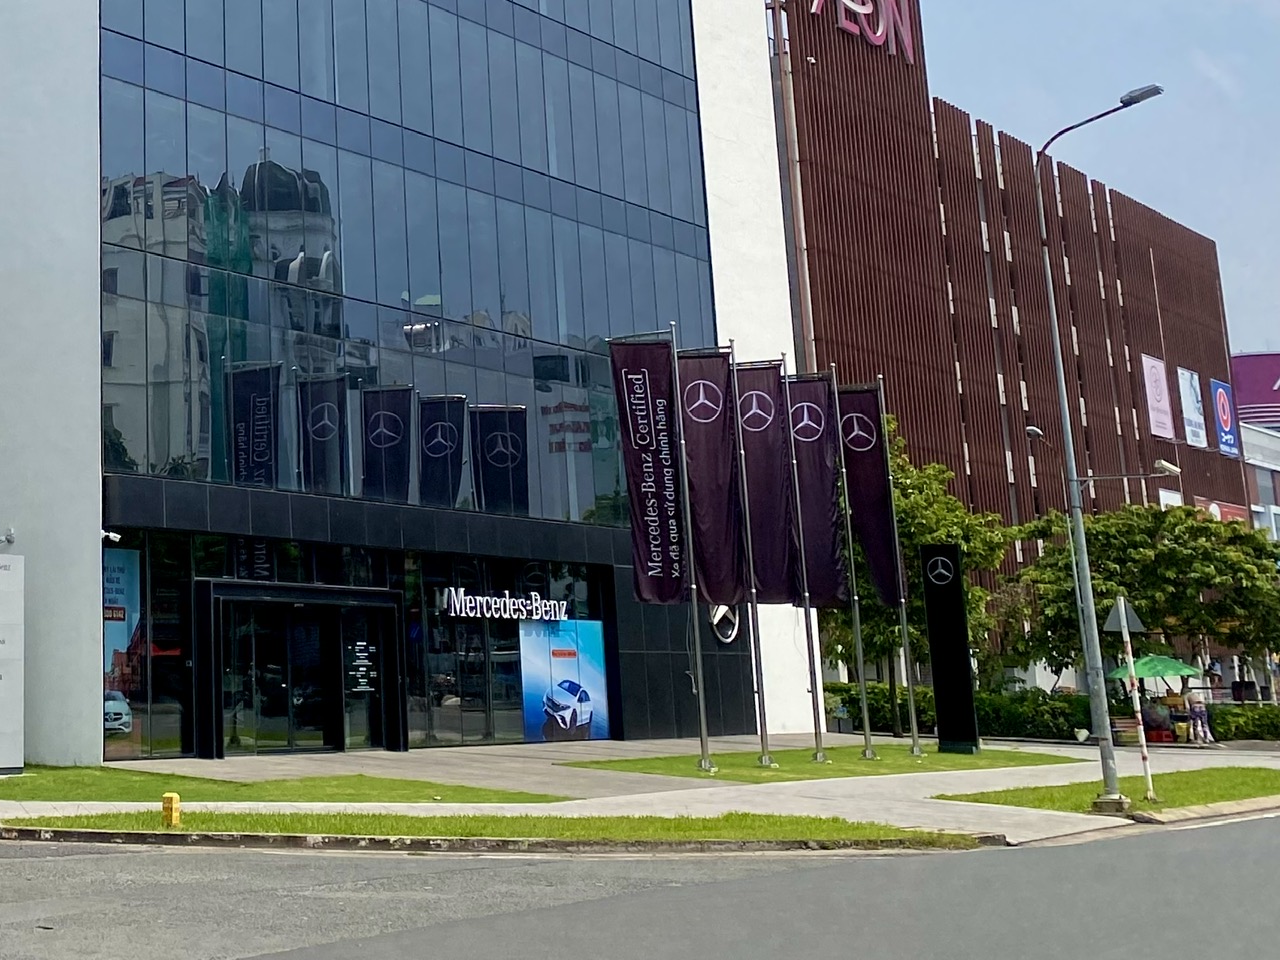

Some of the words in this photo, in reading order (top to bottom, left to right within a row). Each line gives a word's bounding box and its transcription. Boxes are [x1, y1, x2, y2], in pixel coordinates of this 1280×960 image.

[628, 374, 650, 445] Certified
[641, 452, 663, 577] Mercedes-Benz
[668, 519, 679, 542] qua
[449, 587, 568, 620] Mercedes-Benz
